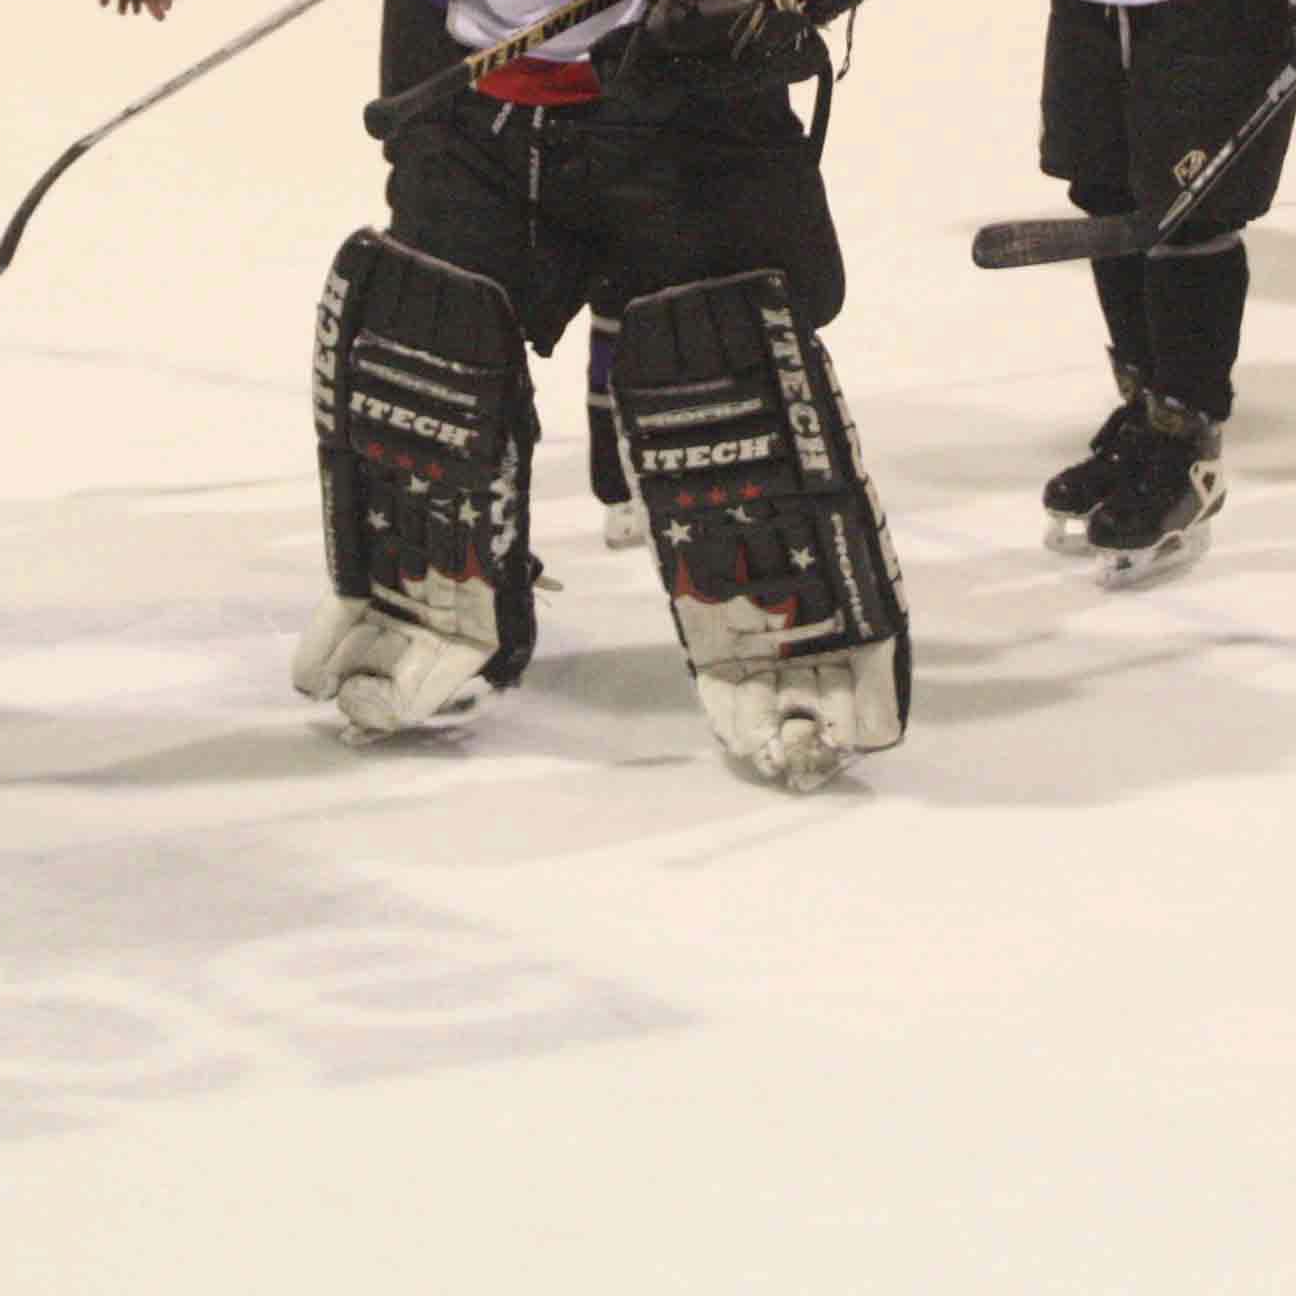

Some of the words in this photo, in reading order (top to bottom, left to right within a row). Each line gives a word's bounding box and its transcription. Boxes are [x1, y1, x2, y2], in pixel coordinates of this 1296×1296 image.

[312, 272, 351, 433] ITECH
[761, 306, 833, 472] ITECH
[349, 390, 480, 449] ITECH
[640, 430, 776, 472] ITECH
